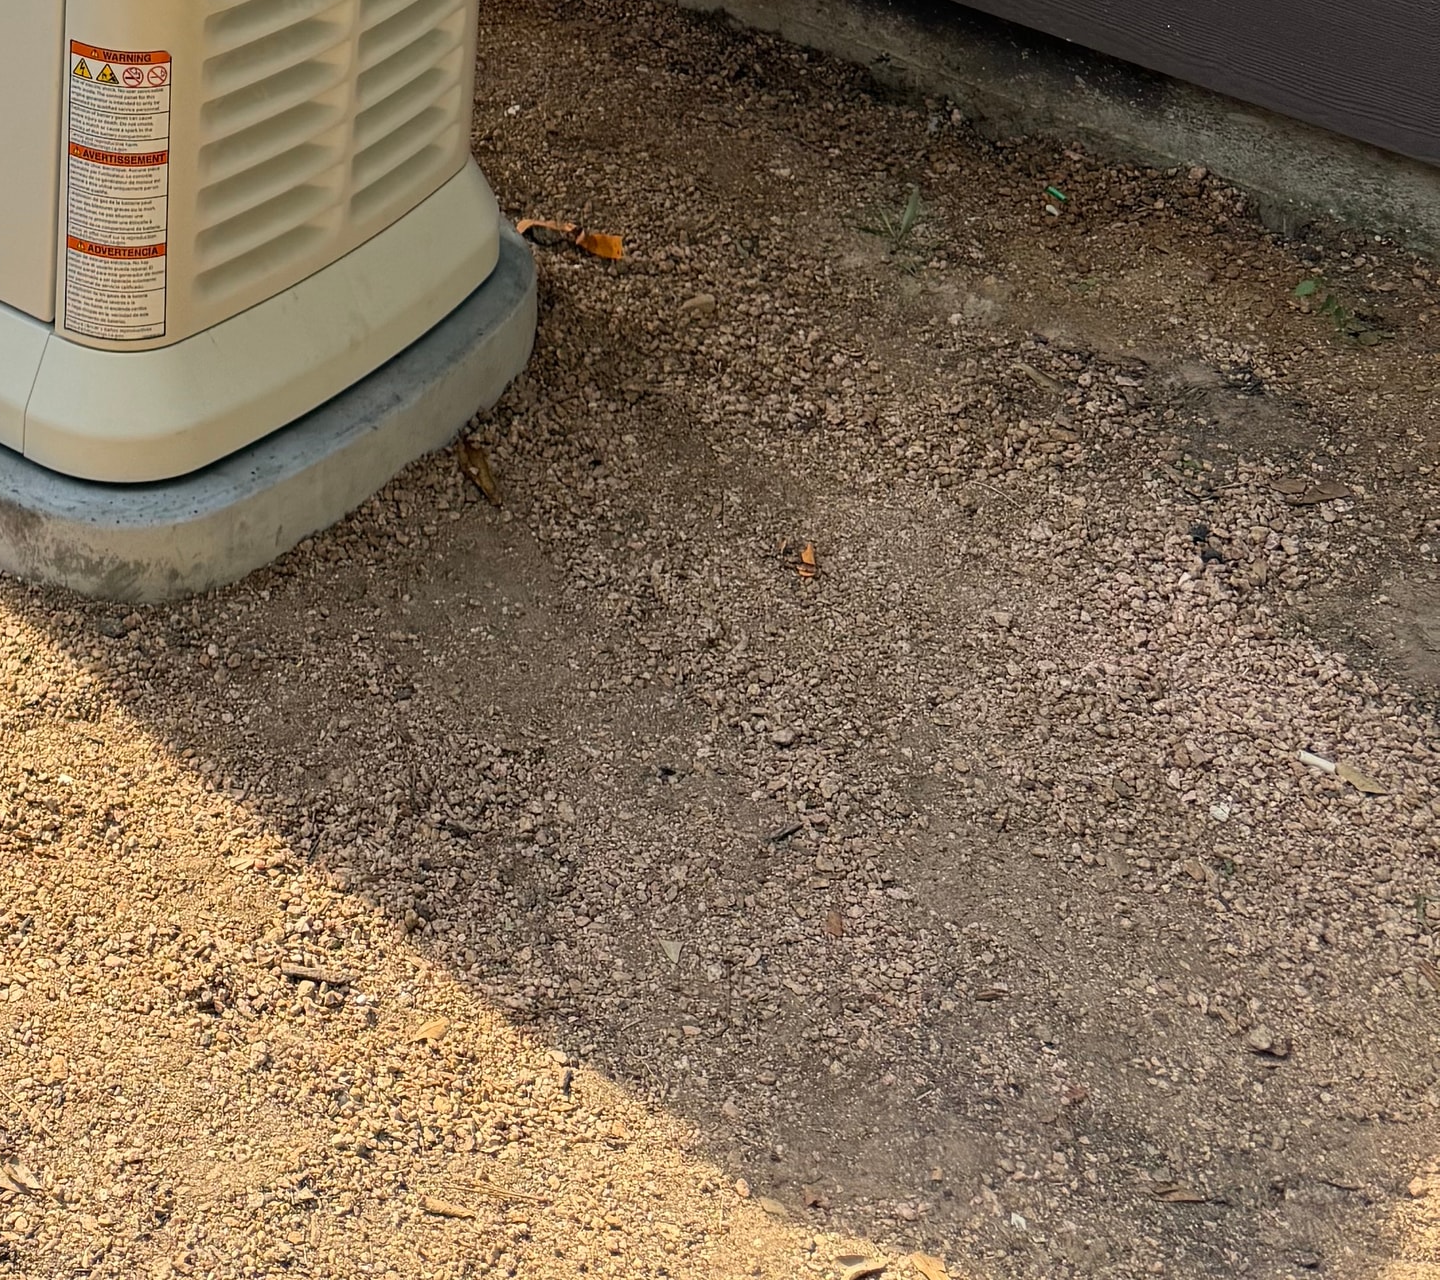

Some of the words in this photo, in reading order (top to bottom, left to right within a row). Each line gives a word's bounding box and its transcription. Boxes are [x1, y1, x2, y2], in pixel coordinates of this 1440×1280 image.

[103, 51, 151, 62] WARNING
[82, 149, 166, 165] AVERTISSEMENT
[87, 244, 158, 256] ADVERTENCIA
